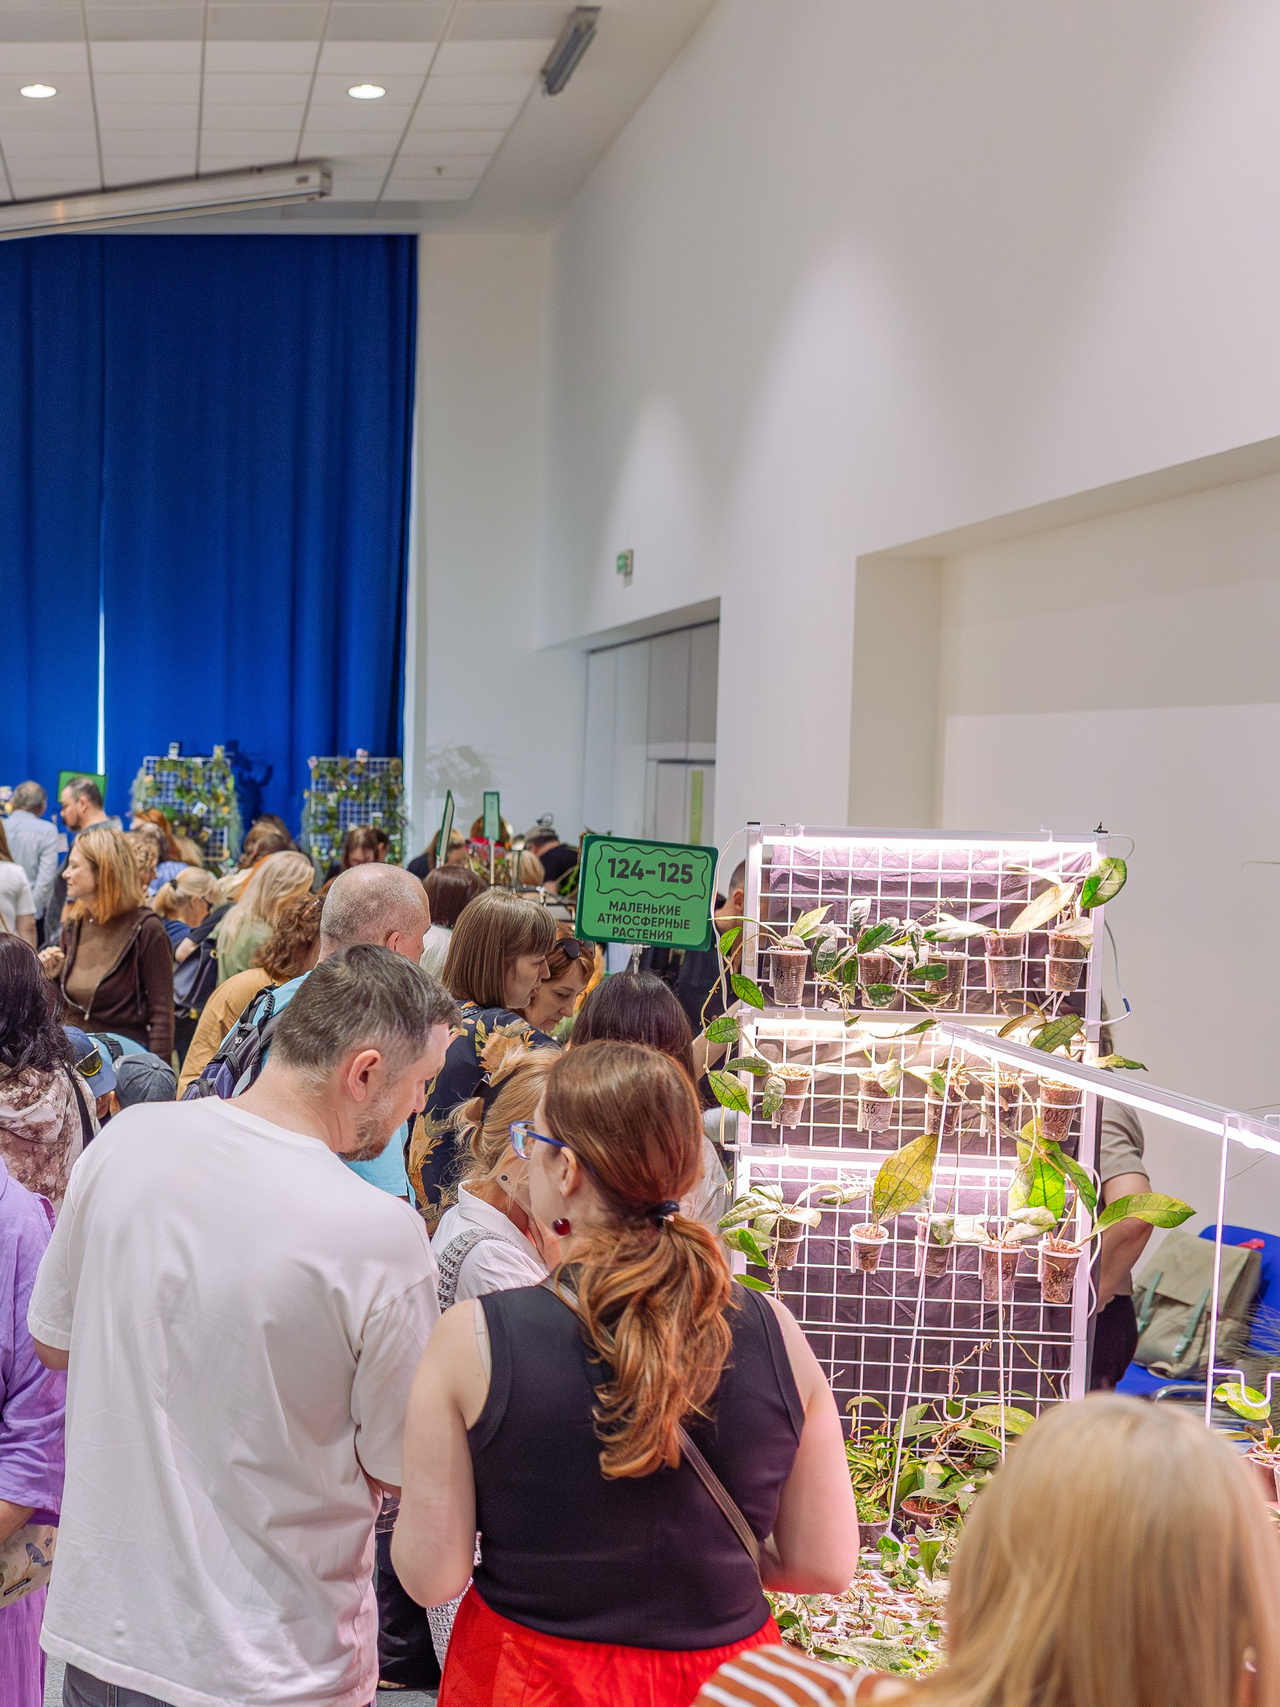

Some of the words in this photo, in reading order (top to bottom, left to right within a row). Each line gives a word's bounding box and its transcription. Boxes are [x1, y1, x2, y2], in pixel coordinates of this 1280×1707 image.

[608, 901, 681, 917] МАЛЕНЬКИЕ
[597, 912, 691, 930] АТМОСФЕРНЫЕ
[612, 926, 673, 941] РАСТЕНИЯ
